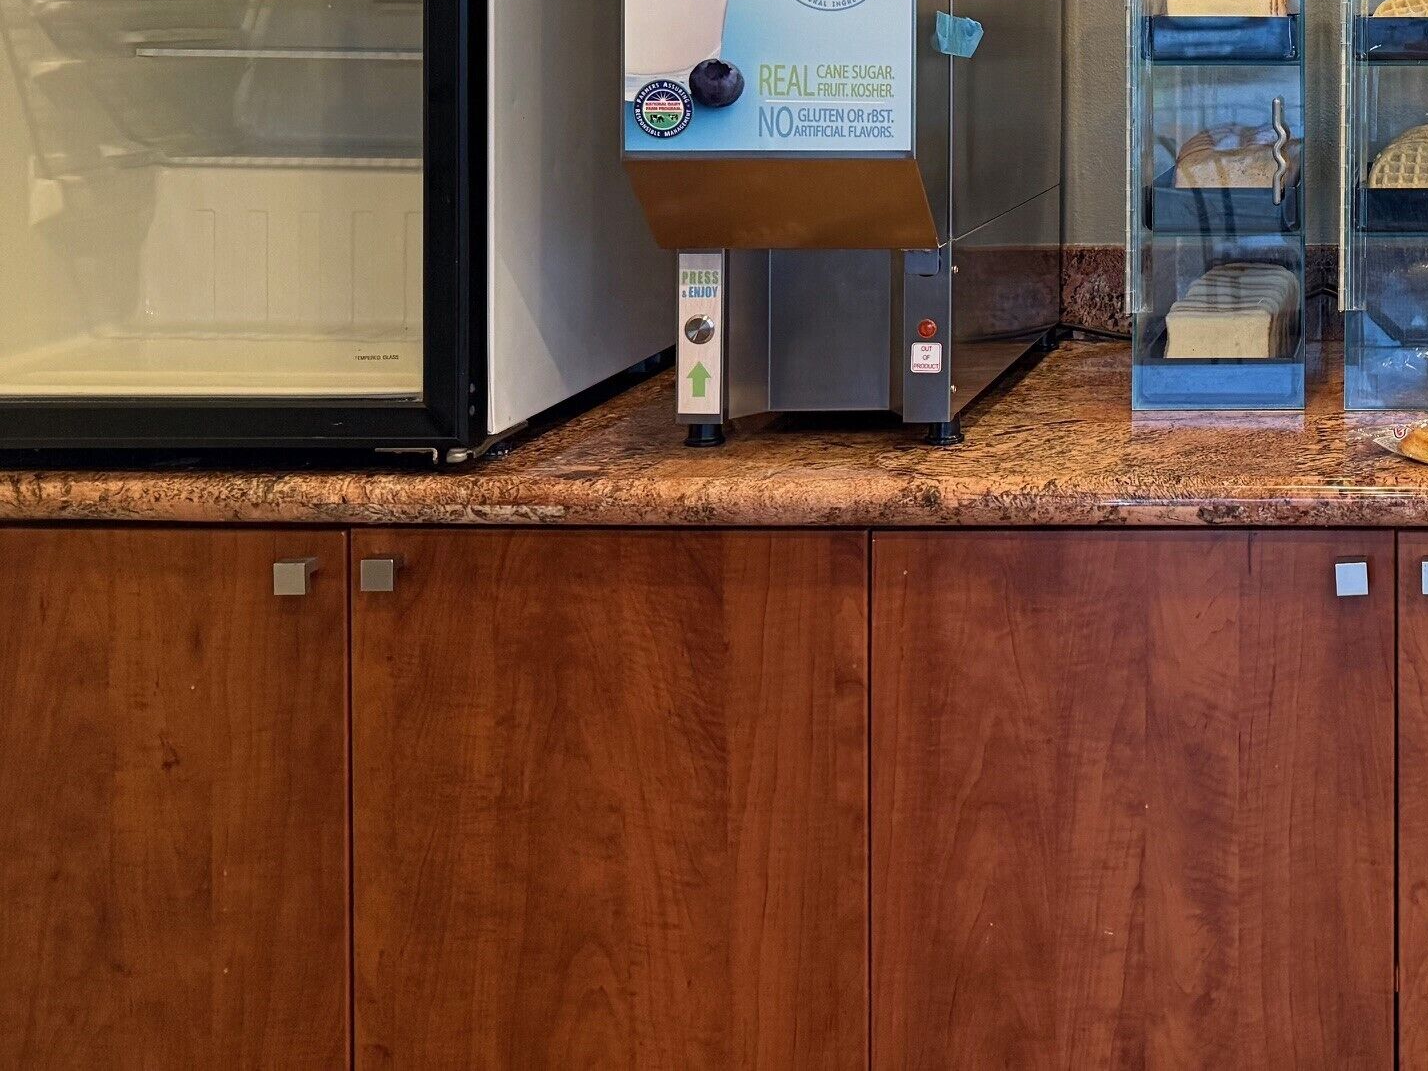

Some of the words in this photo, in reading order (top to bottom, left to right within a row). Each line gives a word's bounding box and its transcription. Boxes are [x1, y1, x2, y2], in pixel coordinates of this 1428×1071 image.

[759, 64, 816, 97] REAL
[816, 64, 849, 79] CANE
[851, 64, 895, 80] SUGAR.
[758, 105, 794, 138] NO
[797, 107, 844, 123] GLUTEN
[846, 108, 865, 123] OR
[793, 124, 847, 138] ARTIFICIAL
[681, 270, 719, 285] PRESS
[688, 286, 719, 298] ENJOY
